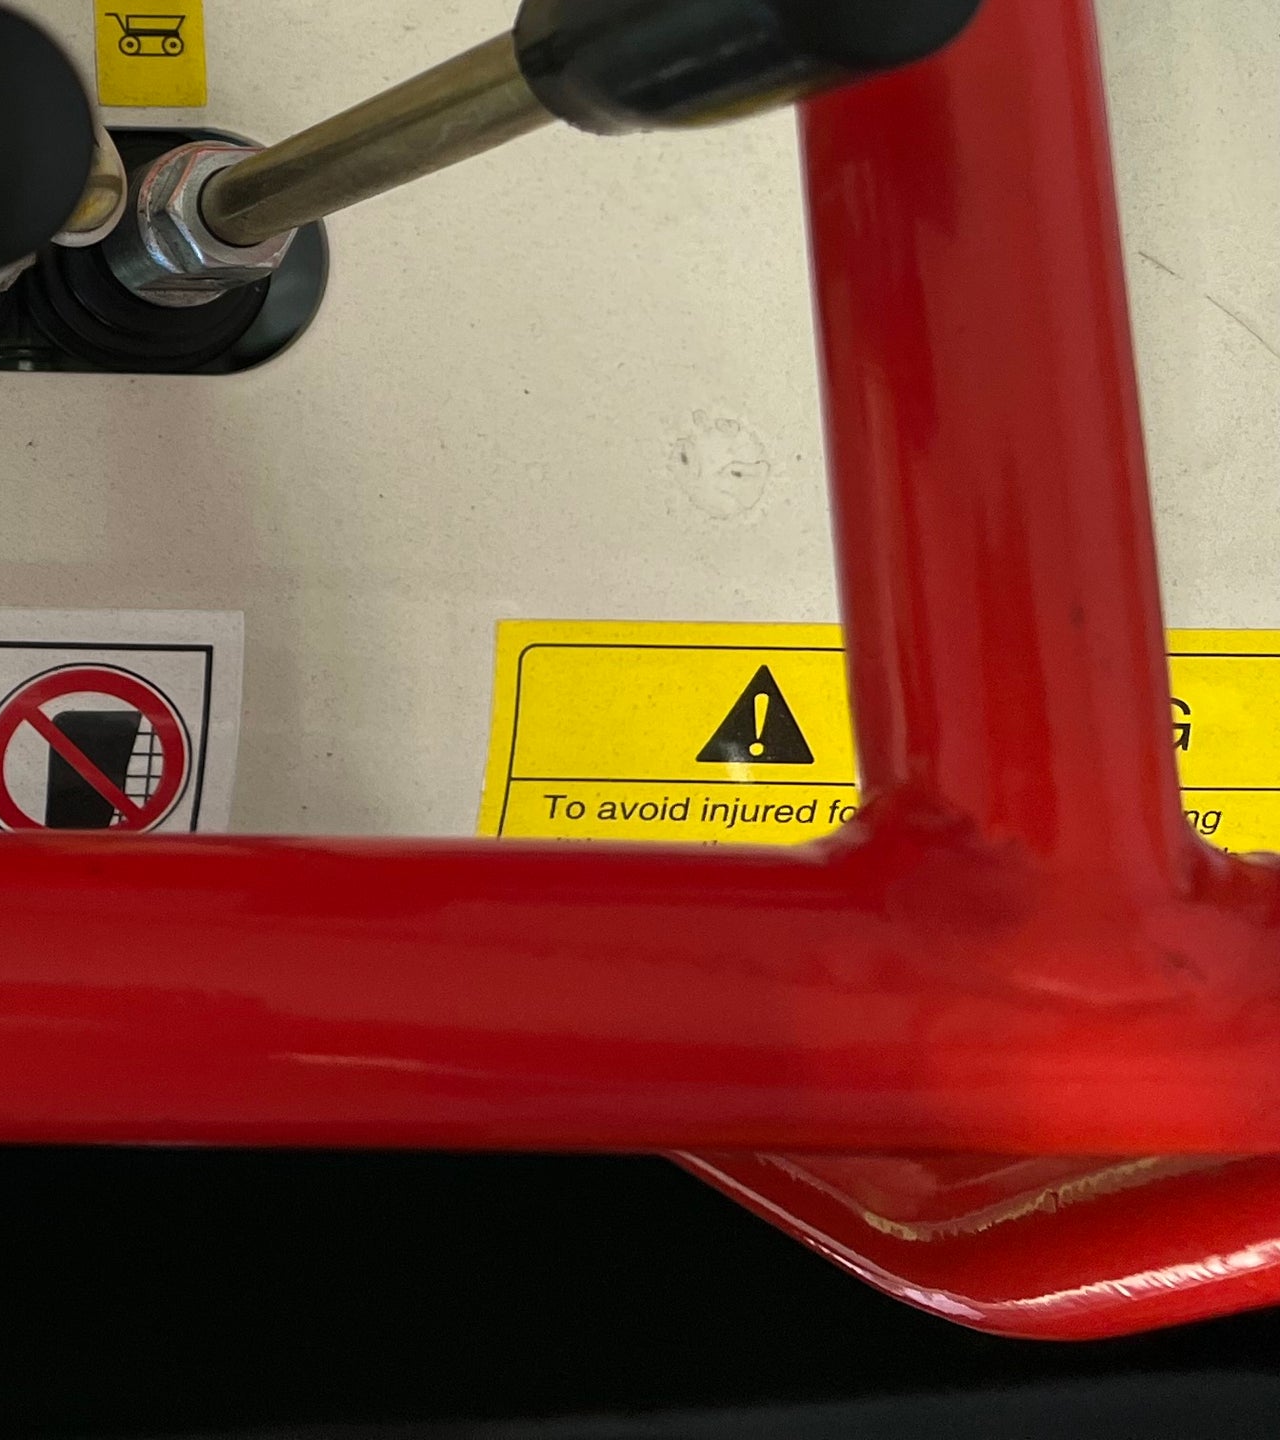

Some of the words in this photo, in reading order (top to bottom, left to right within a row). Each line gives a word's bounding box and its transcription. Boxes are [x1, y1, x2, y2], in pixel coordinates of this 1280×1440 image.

[543, 794, 586, 819] To
[597, 796, 690, 821] avoid
[701, 797, 817, 828] injured
[829, 799, 857, 824] fo
